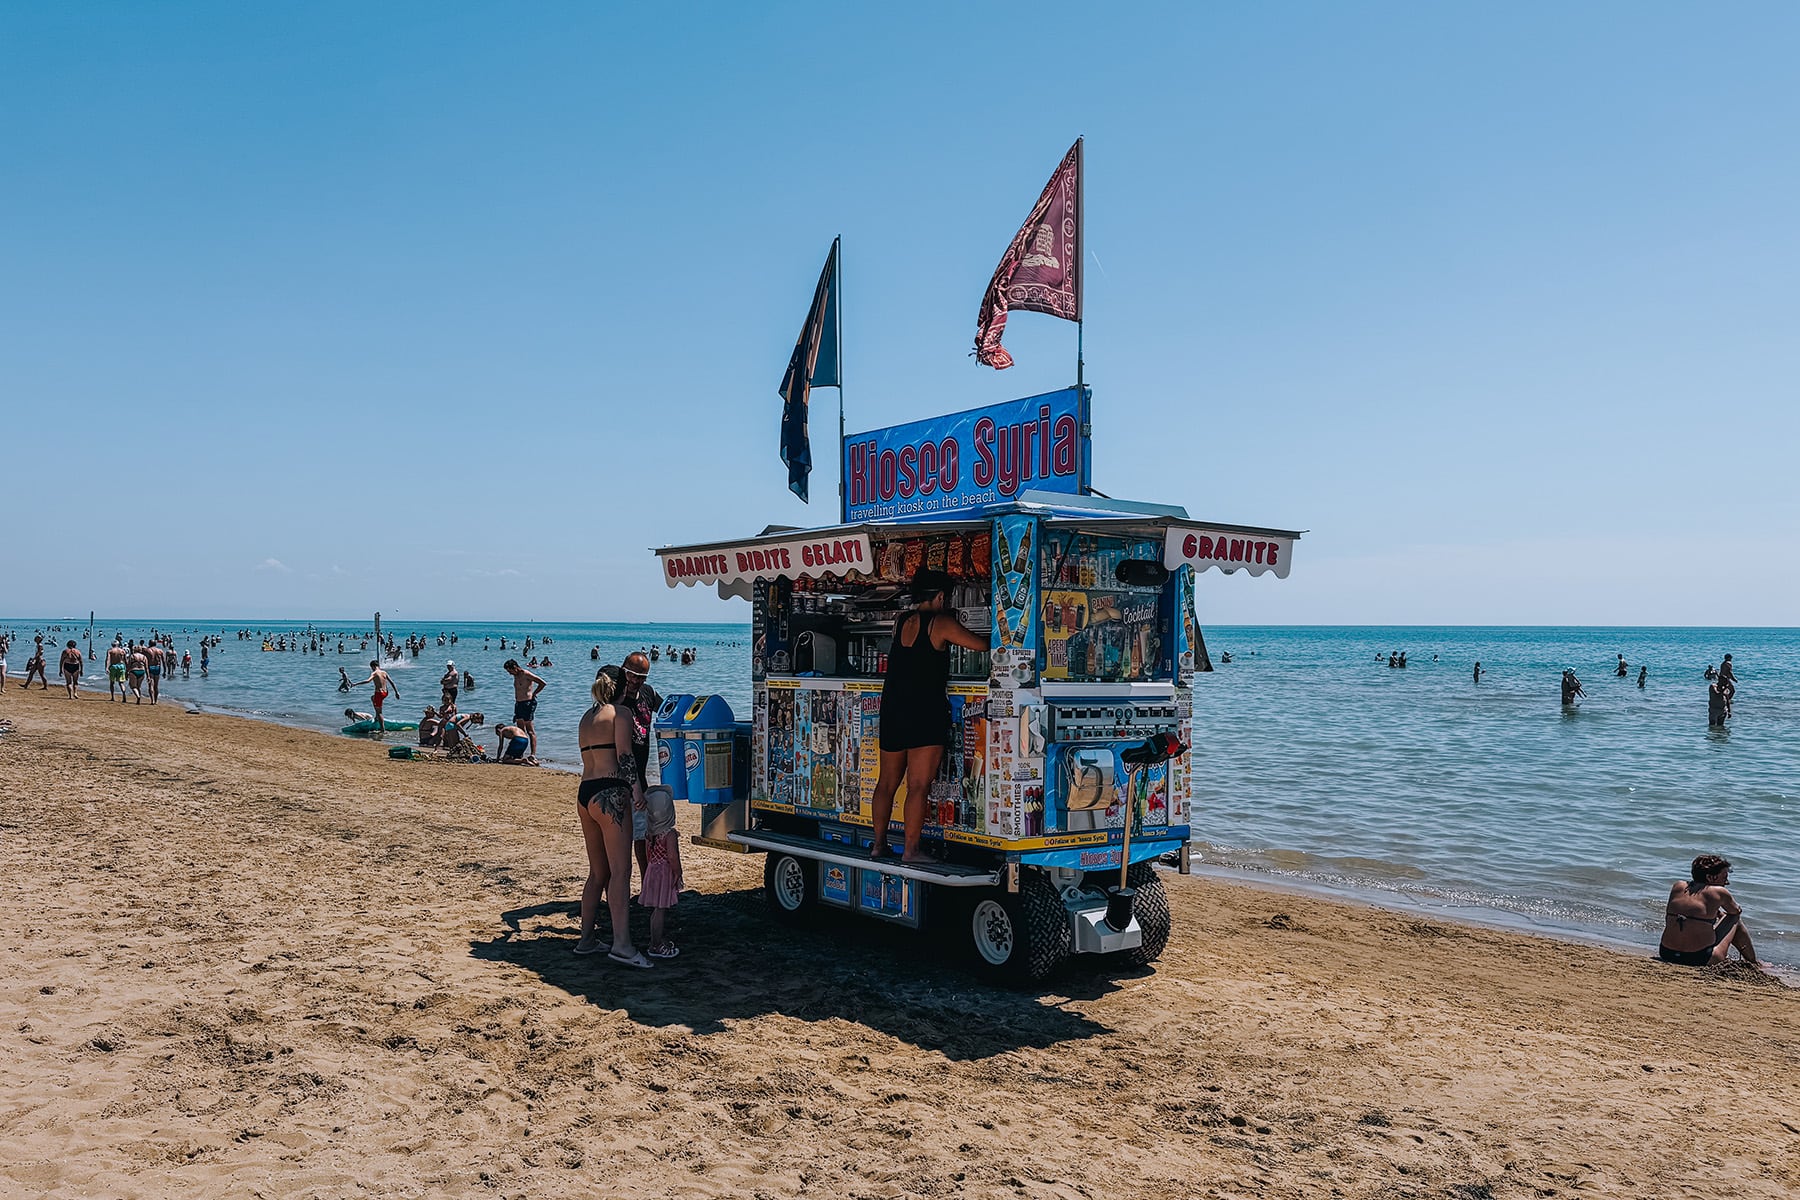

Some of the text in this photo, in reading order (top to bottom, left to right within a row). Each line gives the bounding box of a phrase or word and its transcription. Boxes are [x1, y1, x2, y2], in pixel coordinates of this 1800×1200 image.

[850, 405, 1077, 505] Kiosco Syria
[851, 490, 996, 520] travelling kiosk on the beach
[667, 539, 863, 579] GRANITE BIBITE GELATI
[1182, 534, 1279, 565] GRANITE
[1123, 601, 1155, 625] Cocktail
[1014, 783, 1022, 836] SMOOTHIES
